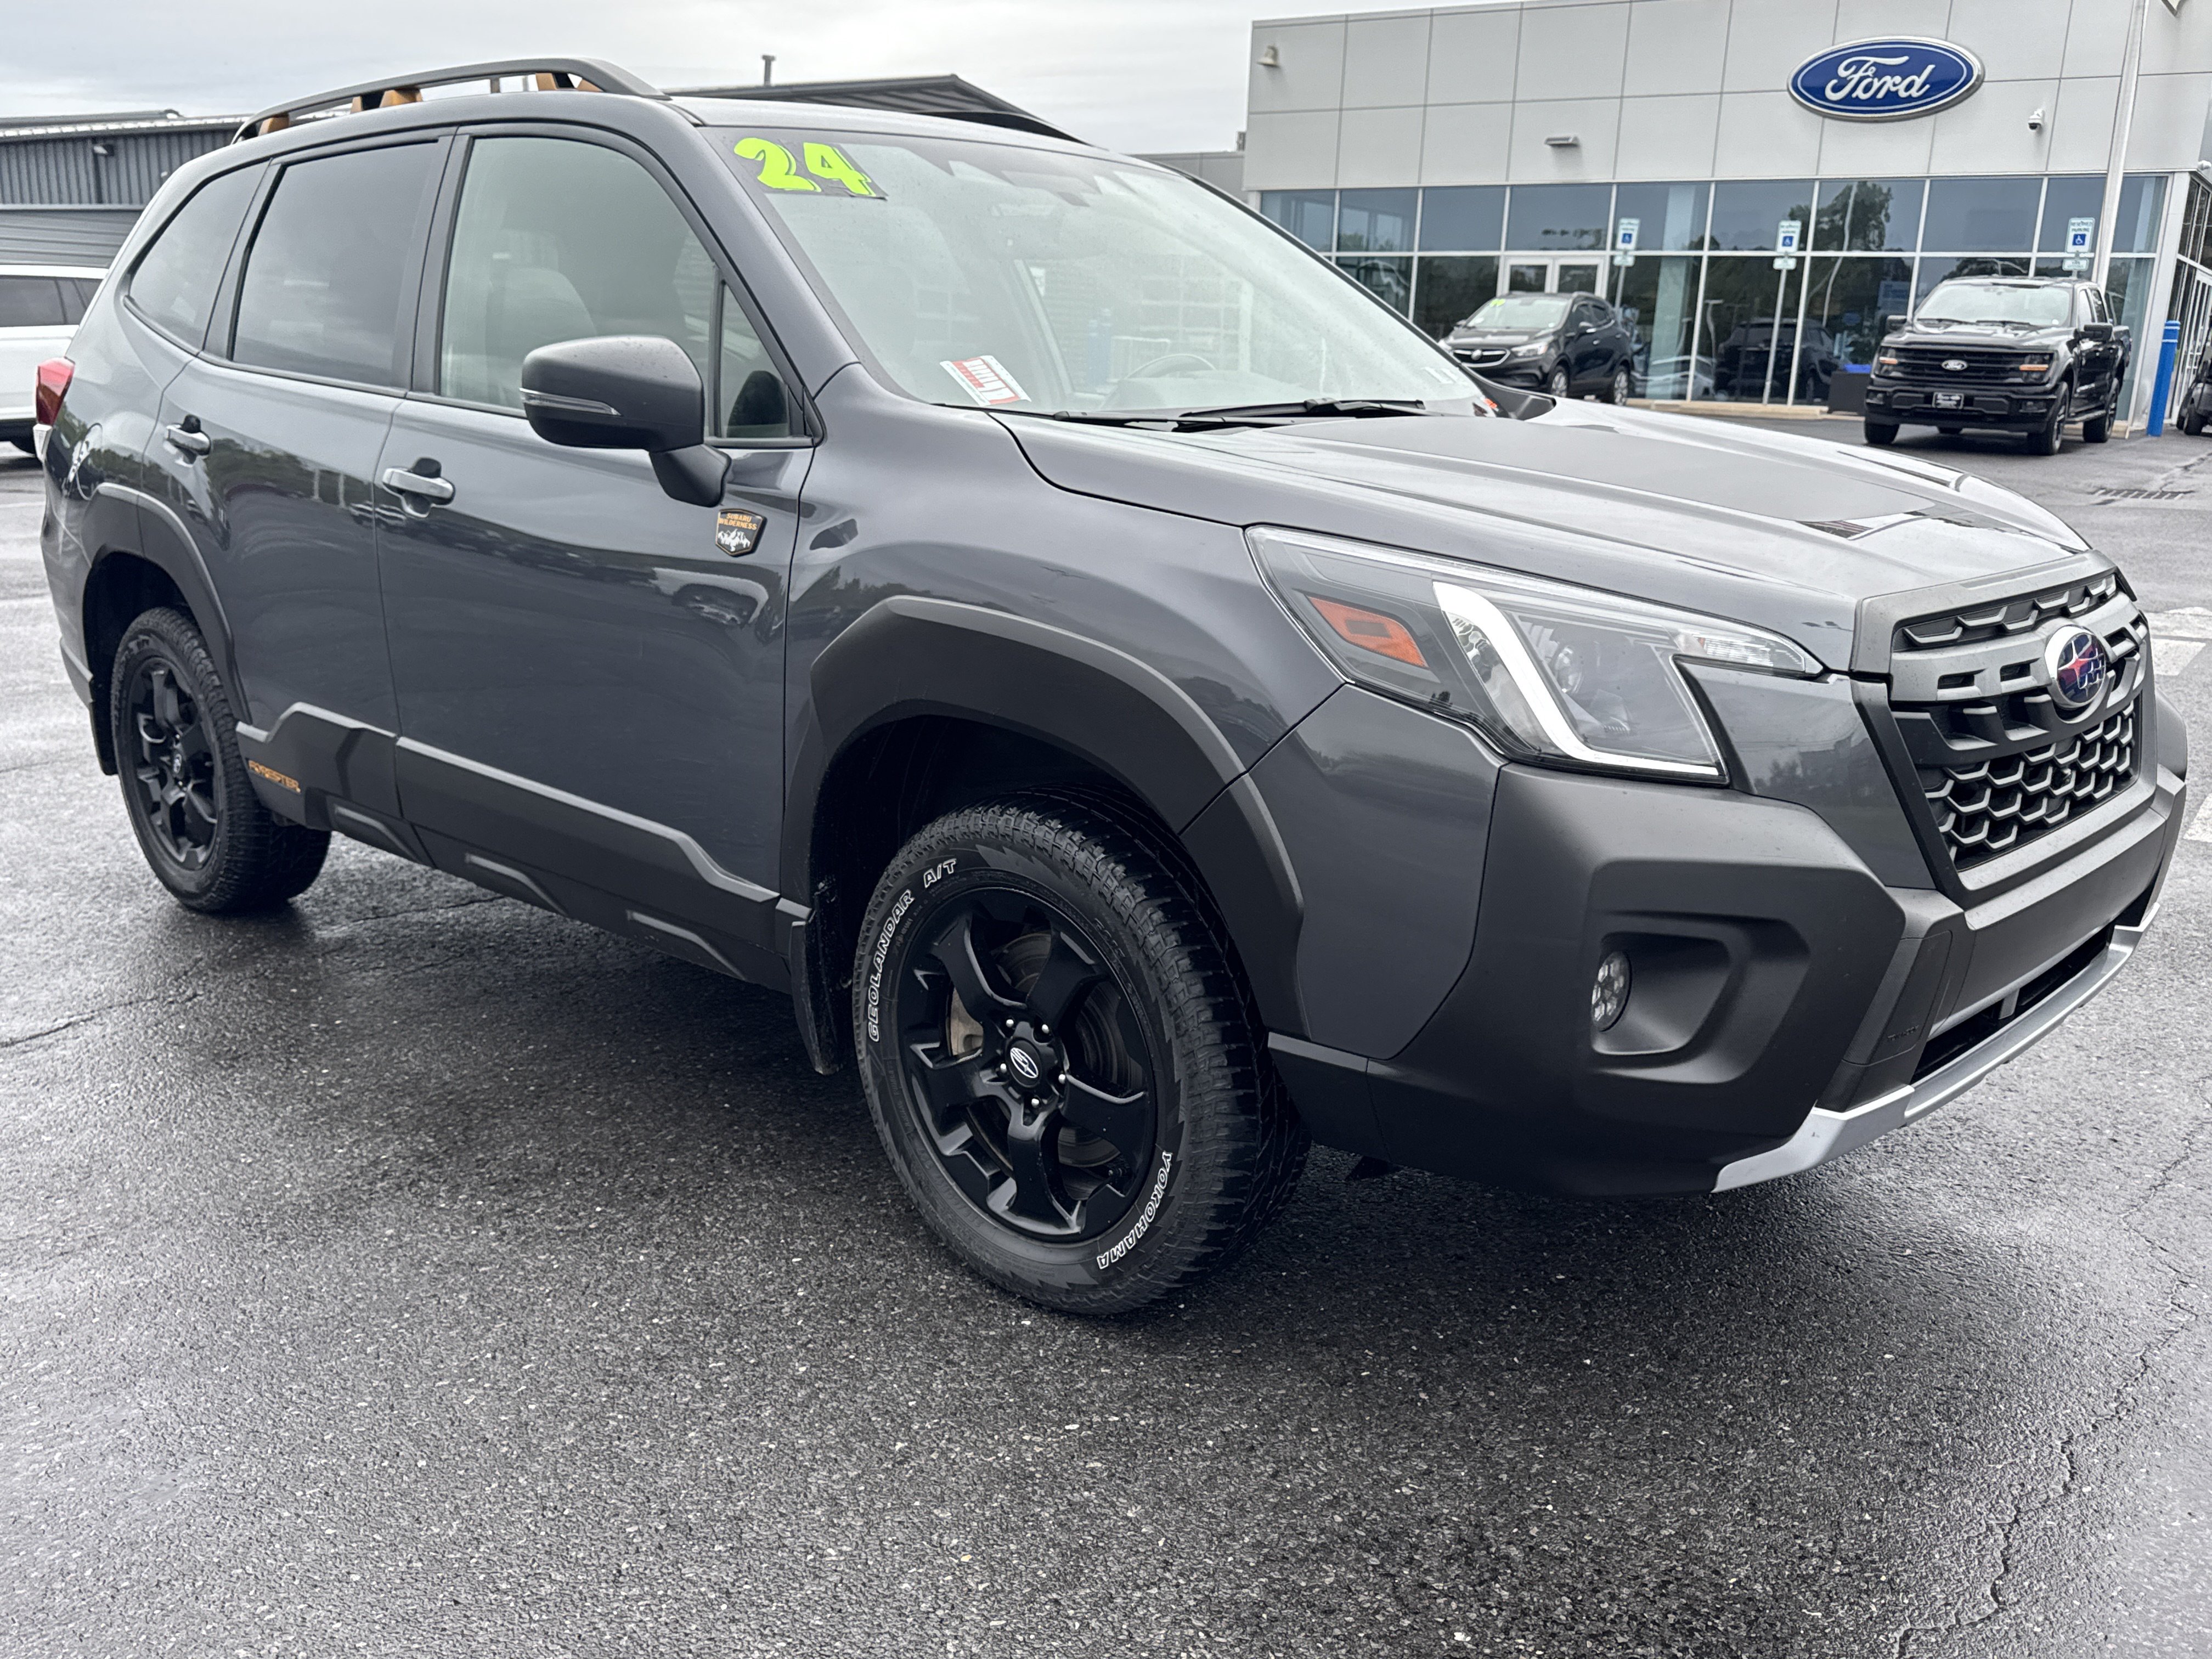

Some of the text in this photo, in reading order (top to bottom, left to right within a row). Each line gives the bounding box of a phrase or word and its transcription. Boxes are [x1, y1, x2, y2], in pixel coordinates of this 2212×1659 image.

[1824, 55, 1936, 101] Ford
[733, 137, 877, 197] 24
[719, 518, 757, 530] WILDERNESS
[727, 513, 752, 522] SUBARU
[248, 759, 301, 793] FORESTER
[868, 889, 916, 1042] GEOLANDAR
[923, 858, 957, 888] A/T
[1097, 1150, 1173, 1269] YOKOHAMA
